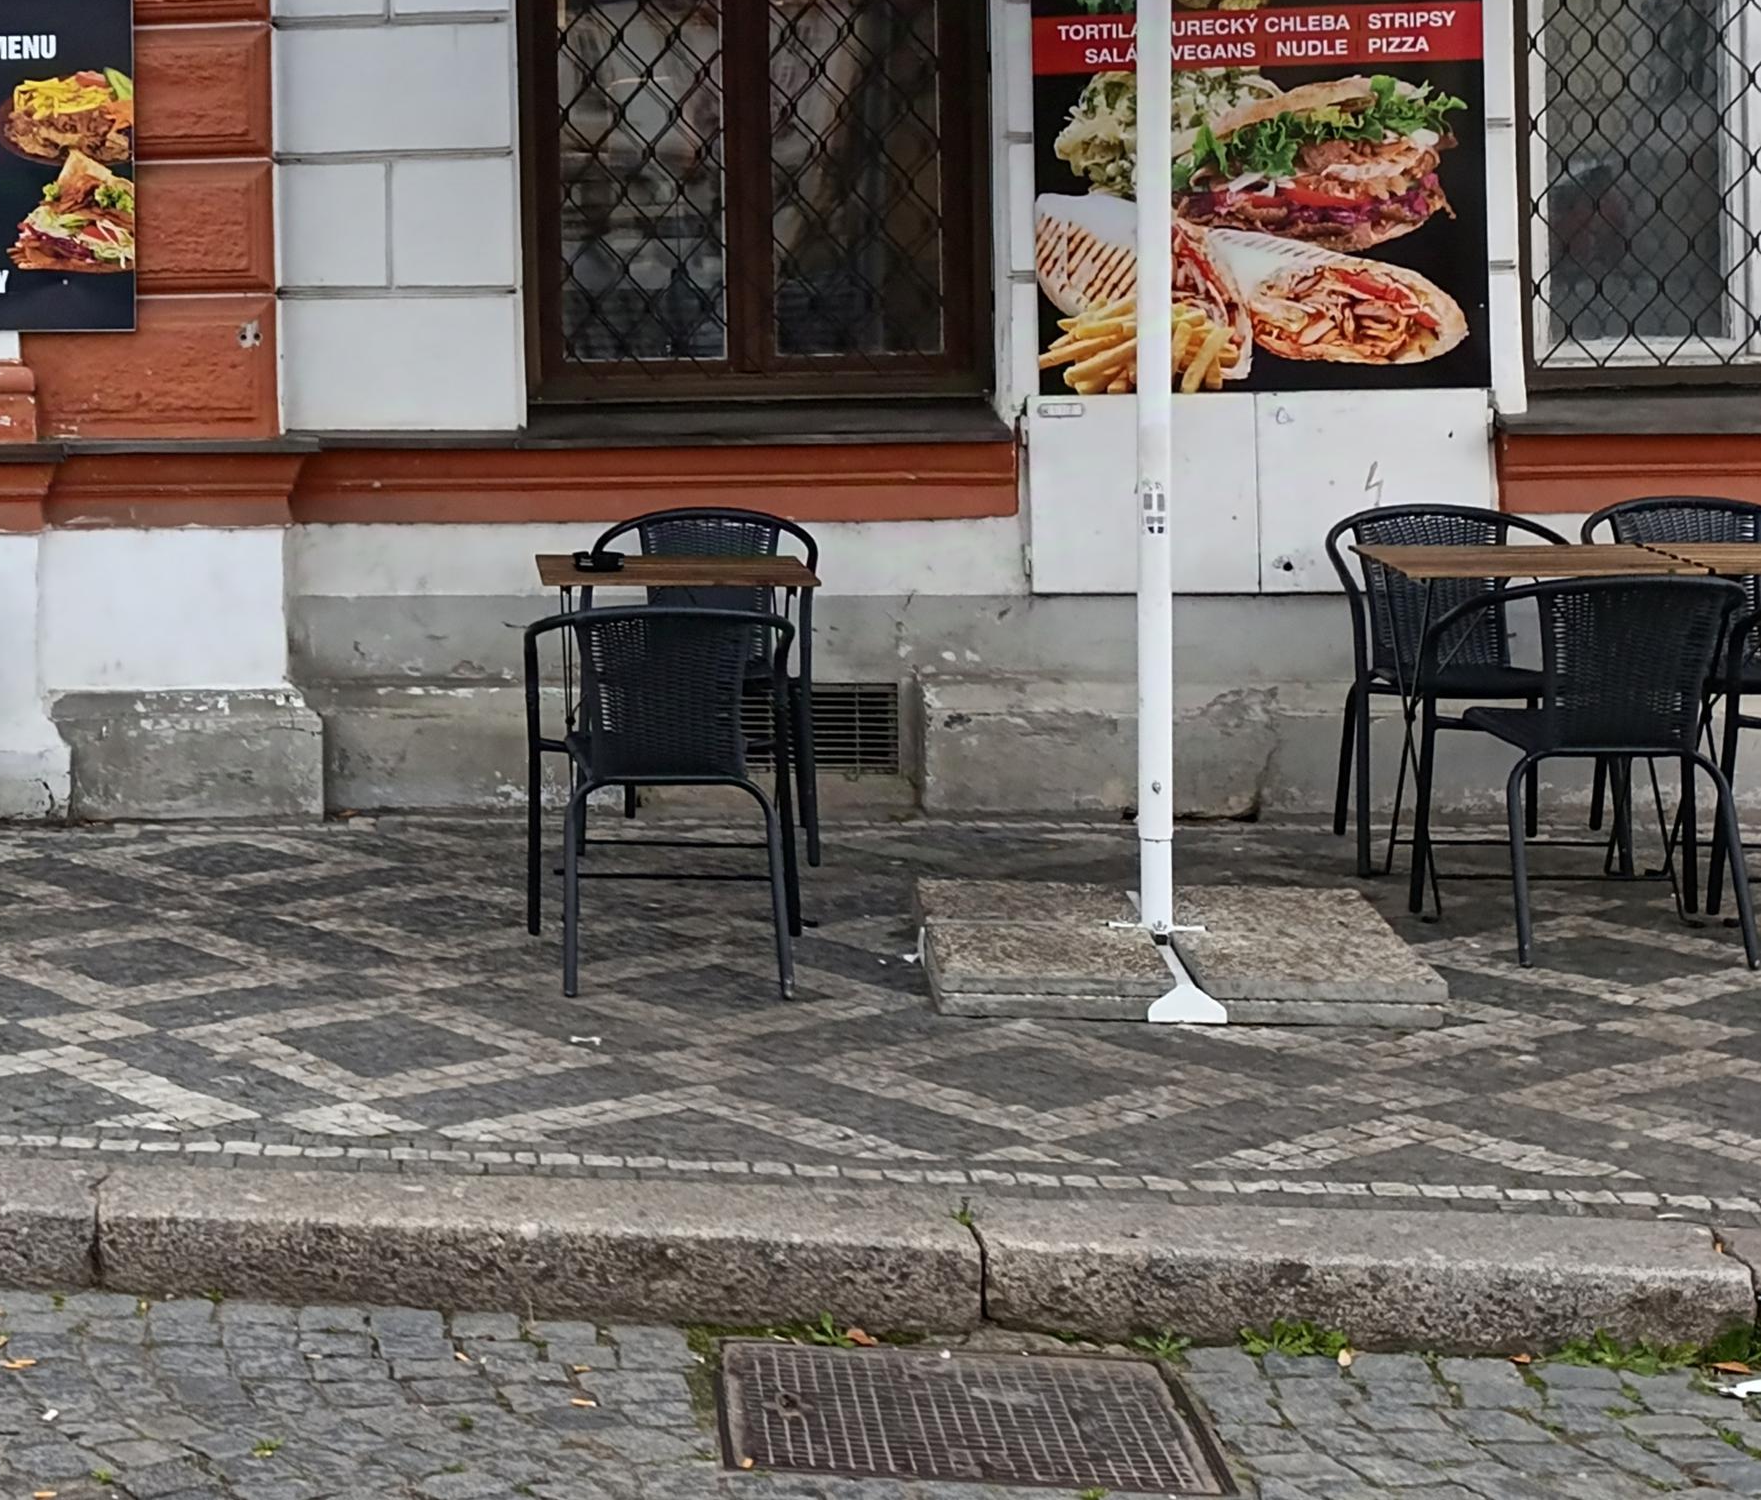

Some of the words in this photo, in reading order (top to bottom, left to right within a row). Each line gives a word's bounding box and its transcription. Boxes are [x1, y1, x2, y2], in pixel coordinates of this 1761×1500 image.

[1171, 14, 1258, 37] URECKÝ
[1265, 14, 1350, 33] CHLEBA
[1367, 11, 1456, 29] STRIPSY
[1171, 42, 1256, 61] VEGANS
[1276, 39, 1348, 57] NUDLE
[1368, 36, 1430, 54] PIZZA
